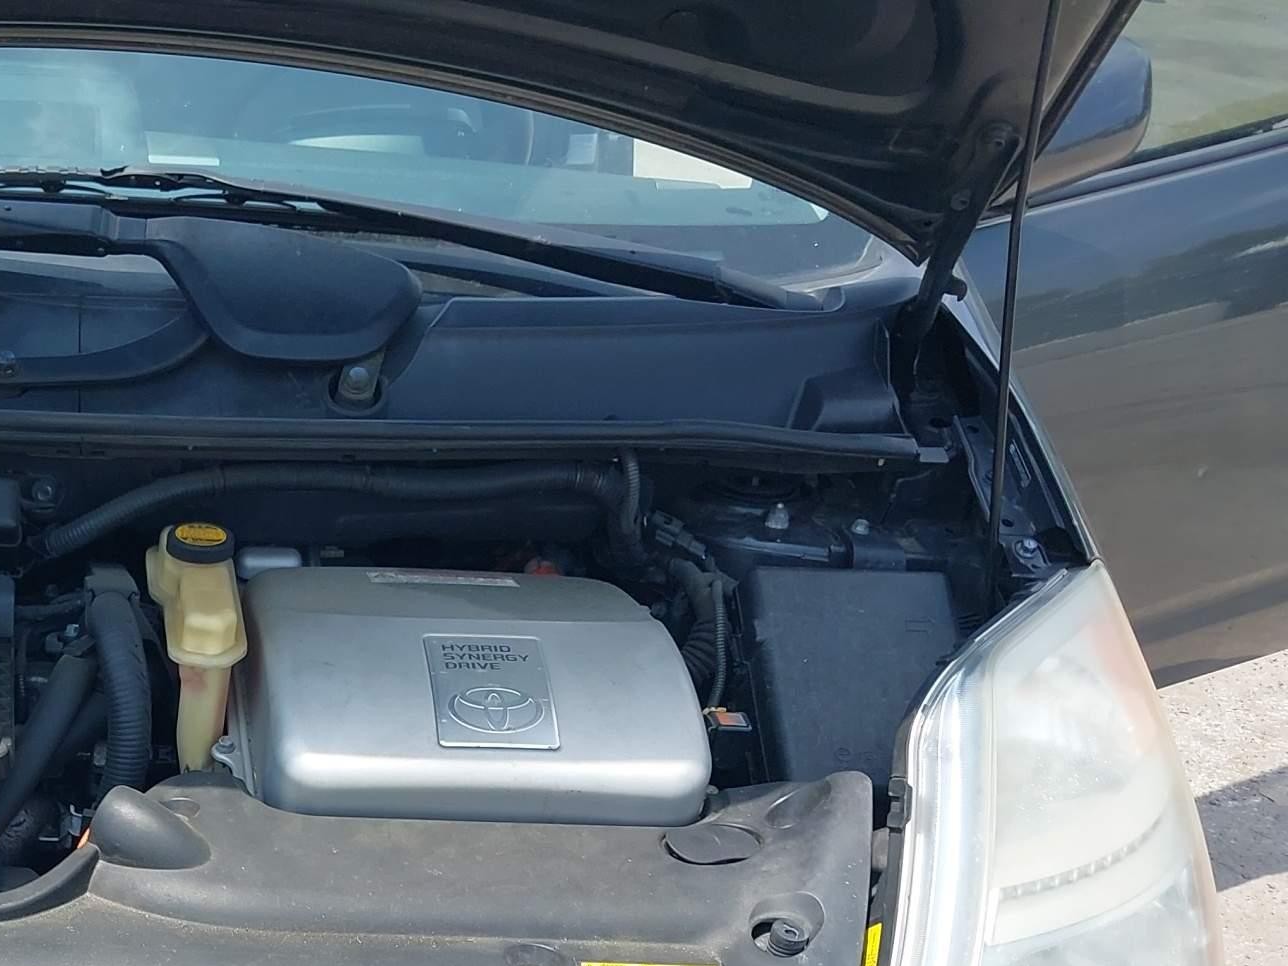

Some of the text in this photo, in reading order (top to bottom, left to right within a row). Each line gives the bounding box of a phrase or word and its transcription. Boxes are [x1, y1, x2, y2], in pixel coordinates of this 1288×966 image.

[441, 644, 511, 652] HYBRID
[443, 653, 529, 662] SYNERGY
[445, 662, 501, 670] DRIVE
